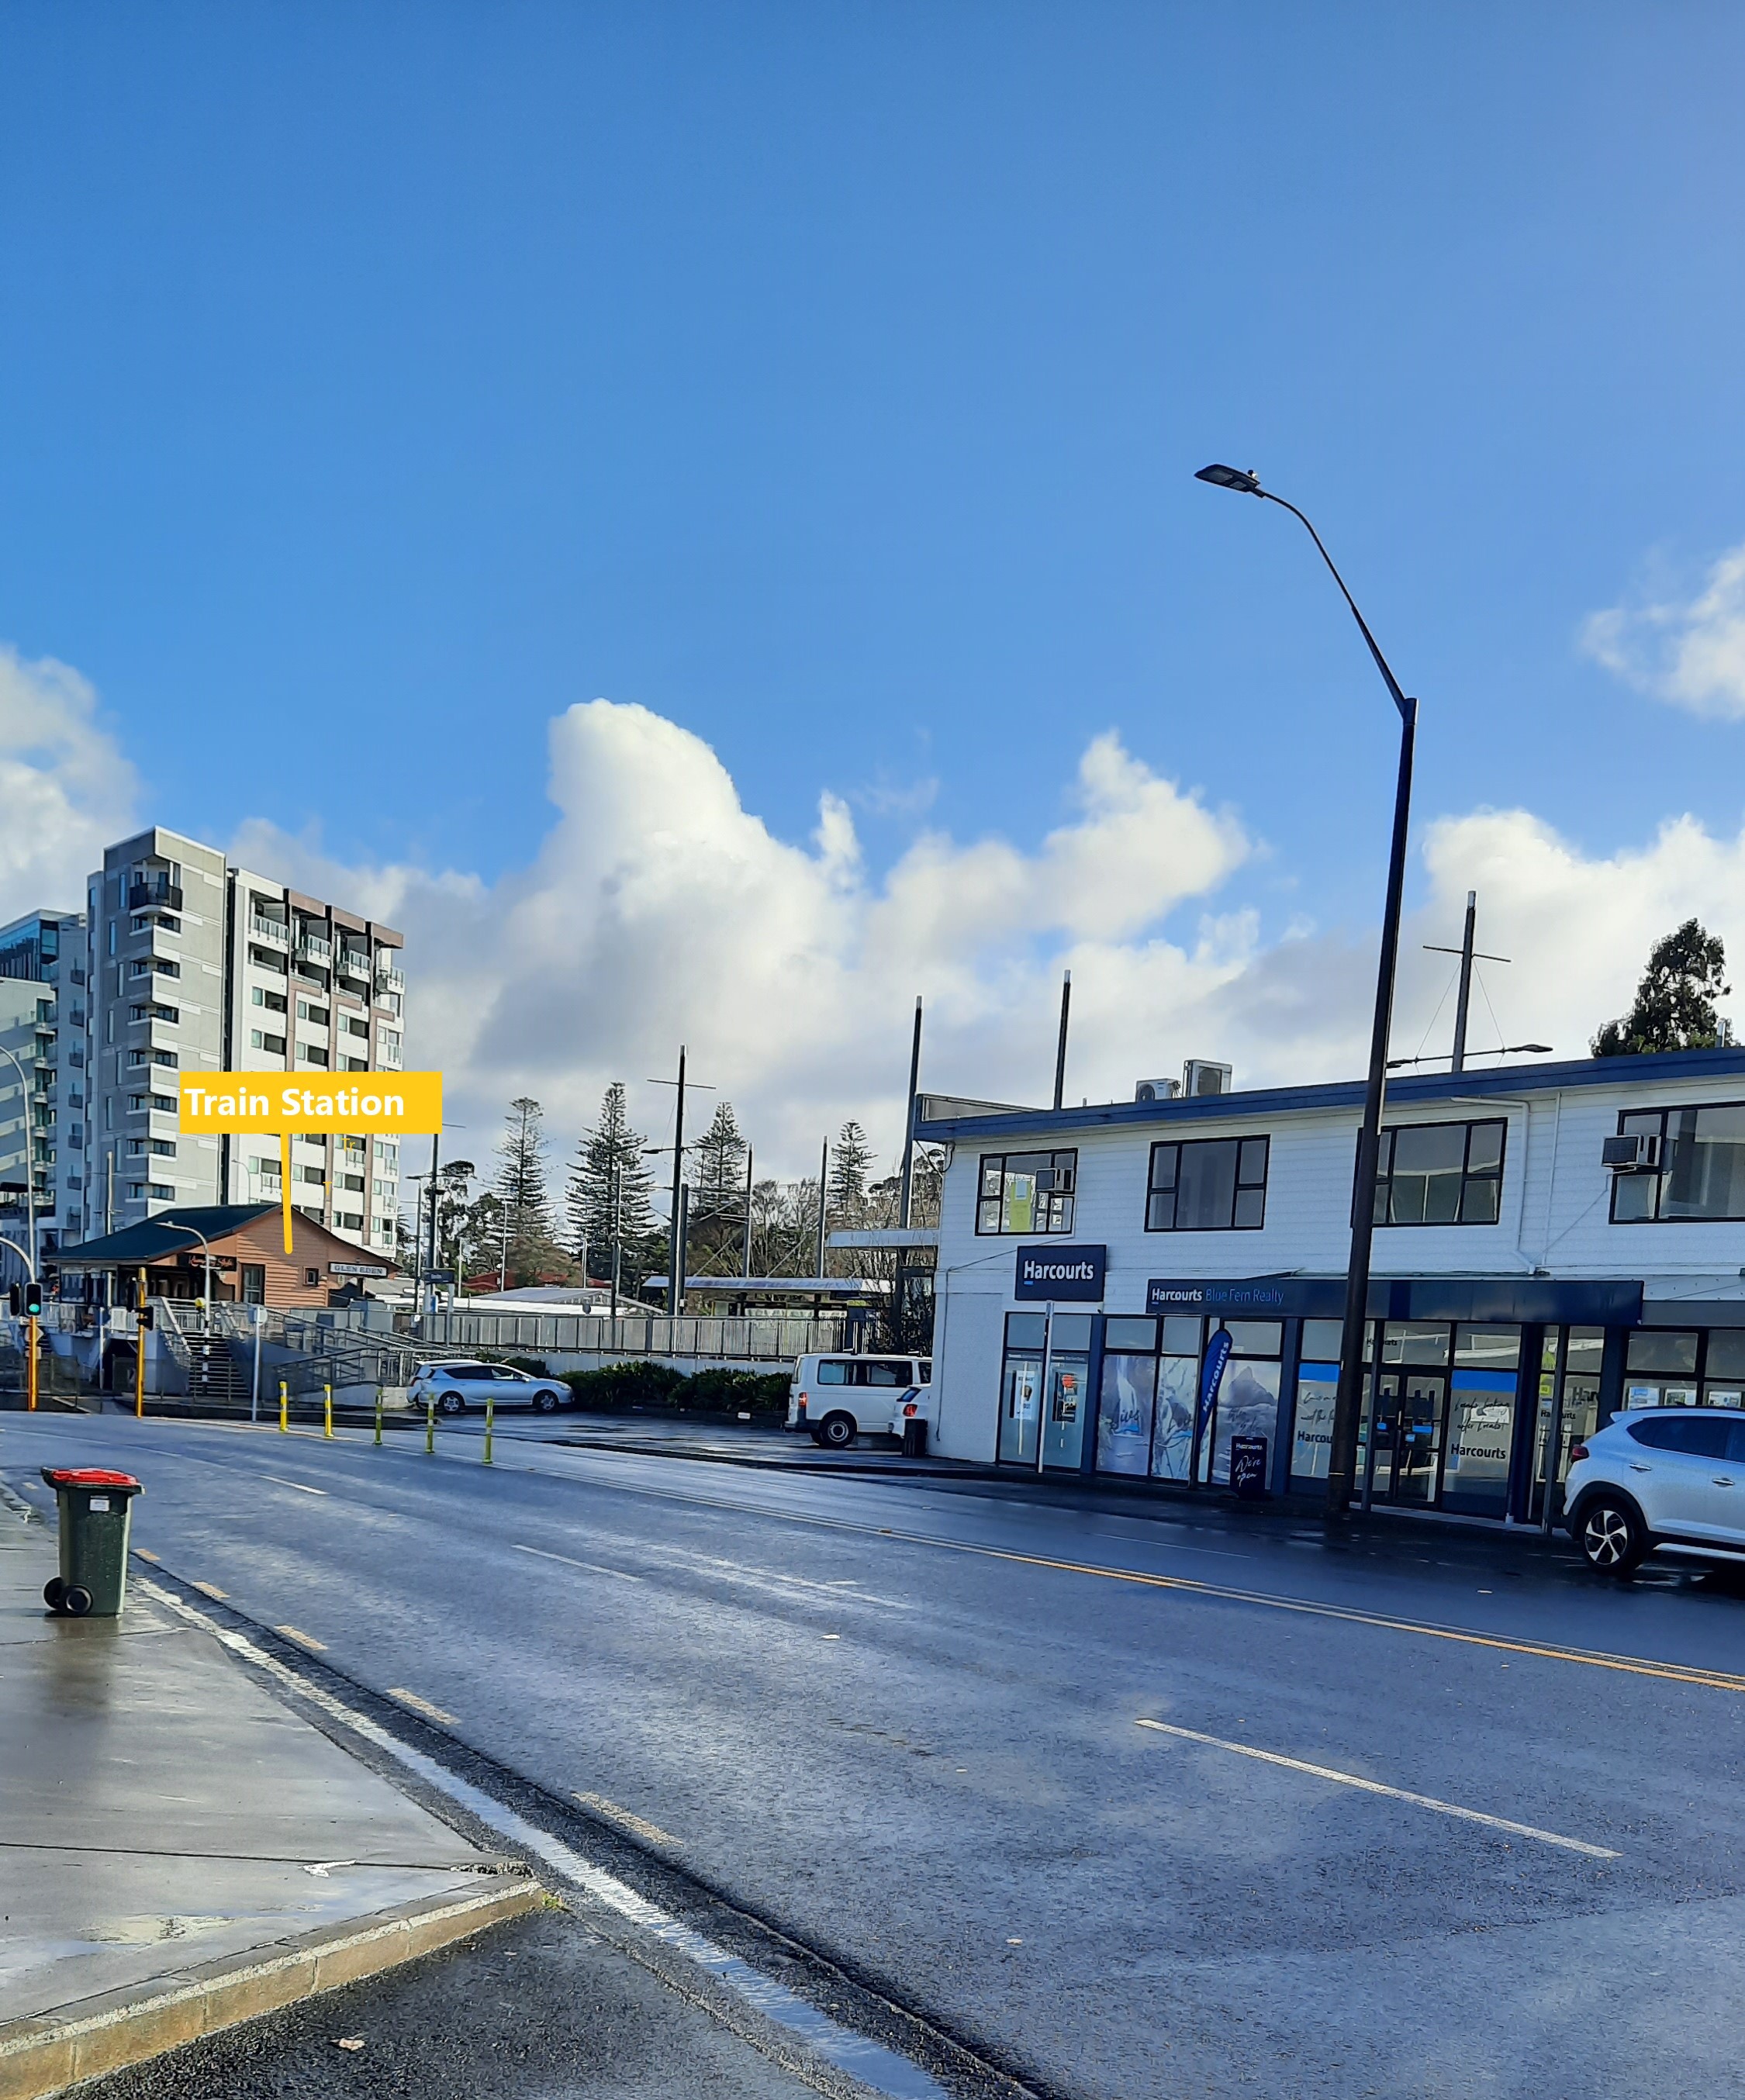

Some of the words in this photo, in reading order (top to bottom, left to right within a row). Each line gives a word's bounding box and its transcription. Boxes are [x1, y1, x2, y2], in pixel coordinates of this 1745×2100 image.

[1024, 1259, 1094, 1280] Harcourts
[1152, 1287, 1203, 1302] Harcourts
[1205, 1288, 1228, 1302] Blue
[1229, 1288, 1250, 1302] Fern
[1253, 1288, 1284, 1306] Realty
[1203, 1341, 1230, 1414] Harcourts
[1450, 1443, 1506, 1459] Harcourts
